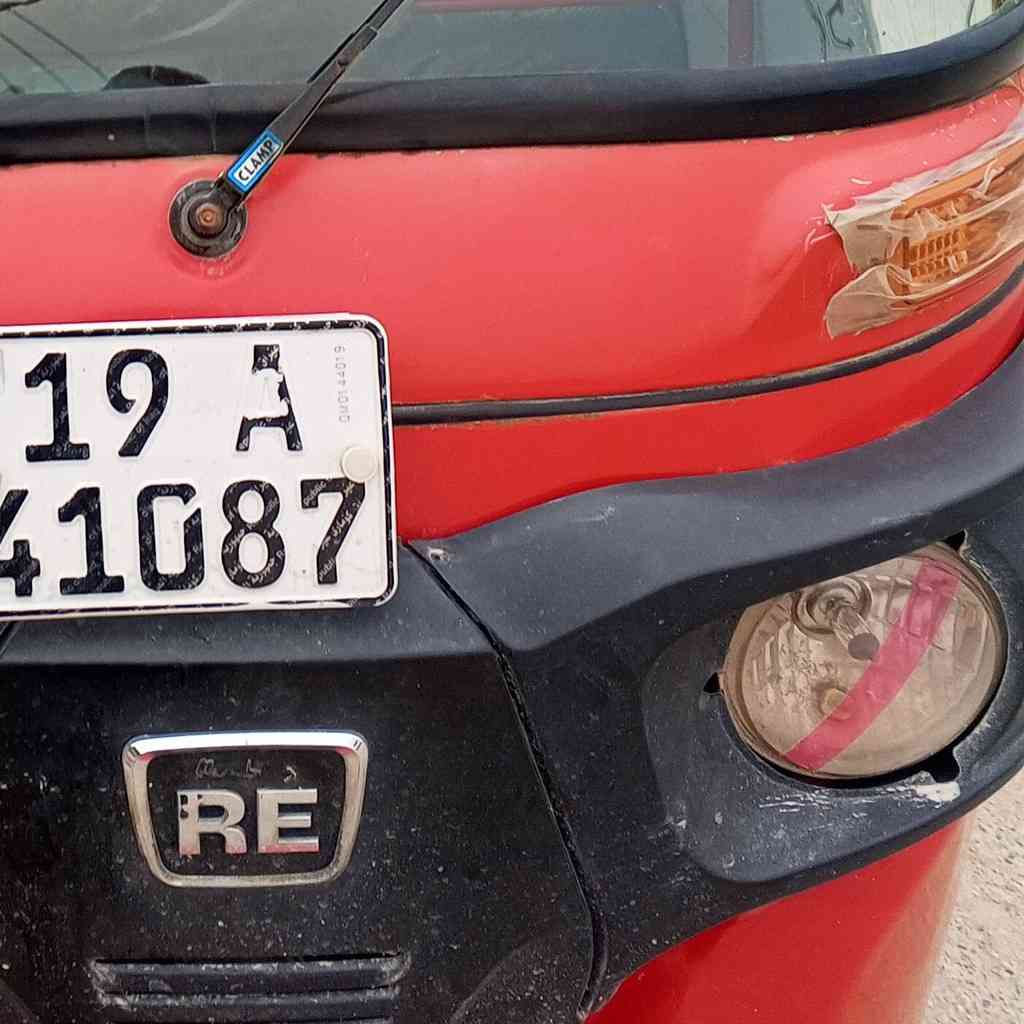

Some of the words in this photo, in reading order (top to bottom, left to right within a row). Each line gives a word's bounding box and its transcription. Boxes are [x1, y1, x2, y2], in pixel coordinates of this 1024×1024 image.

[237, 139, 275, 181] CLAMP
[23, 348, 169, 463] 19
[176, 787, 321, 857] RE
